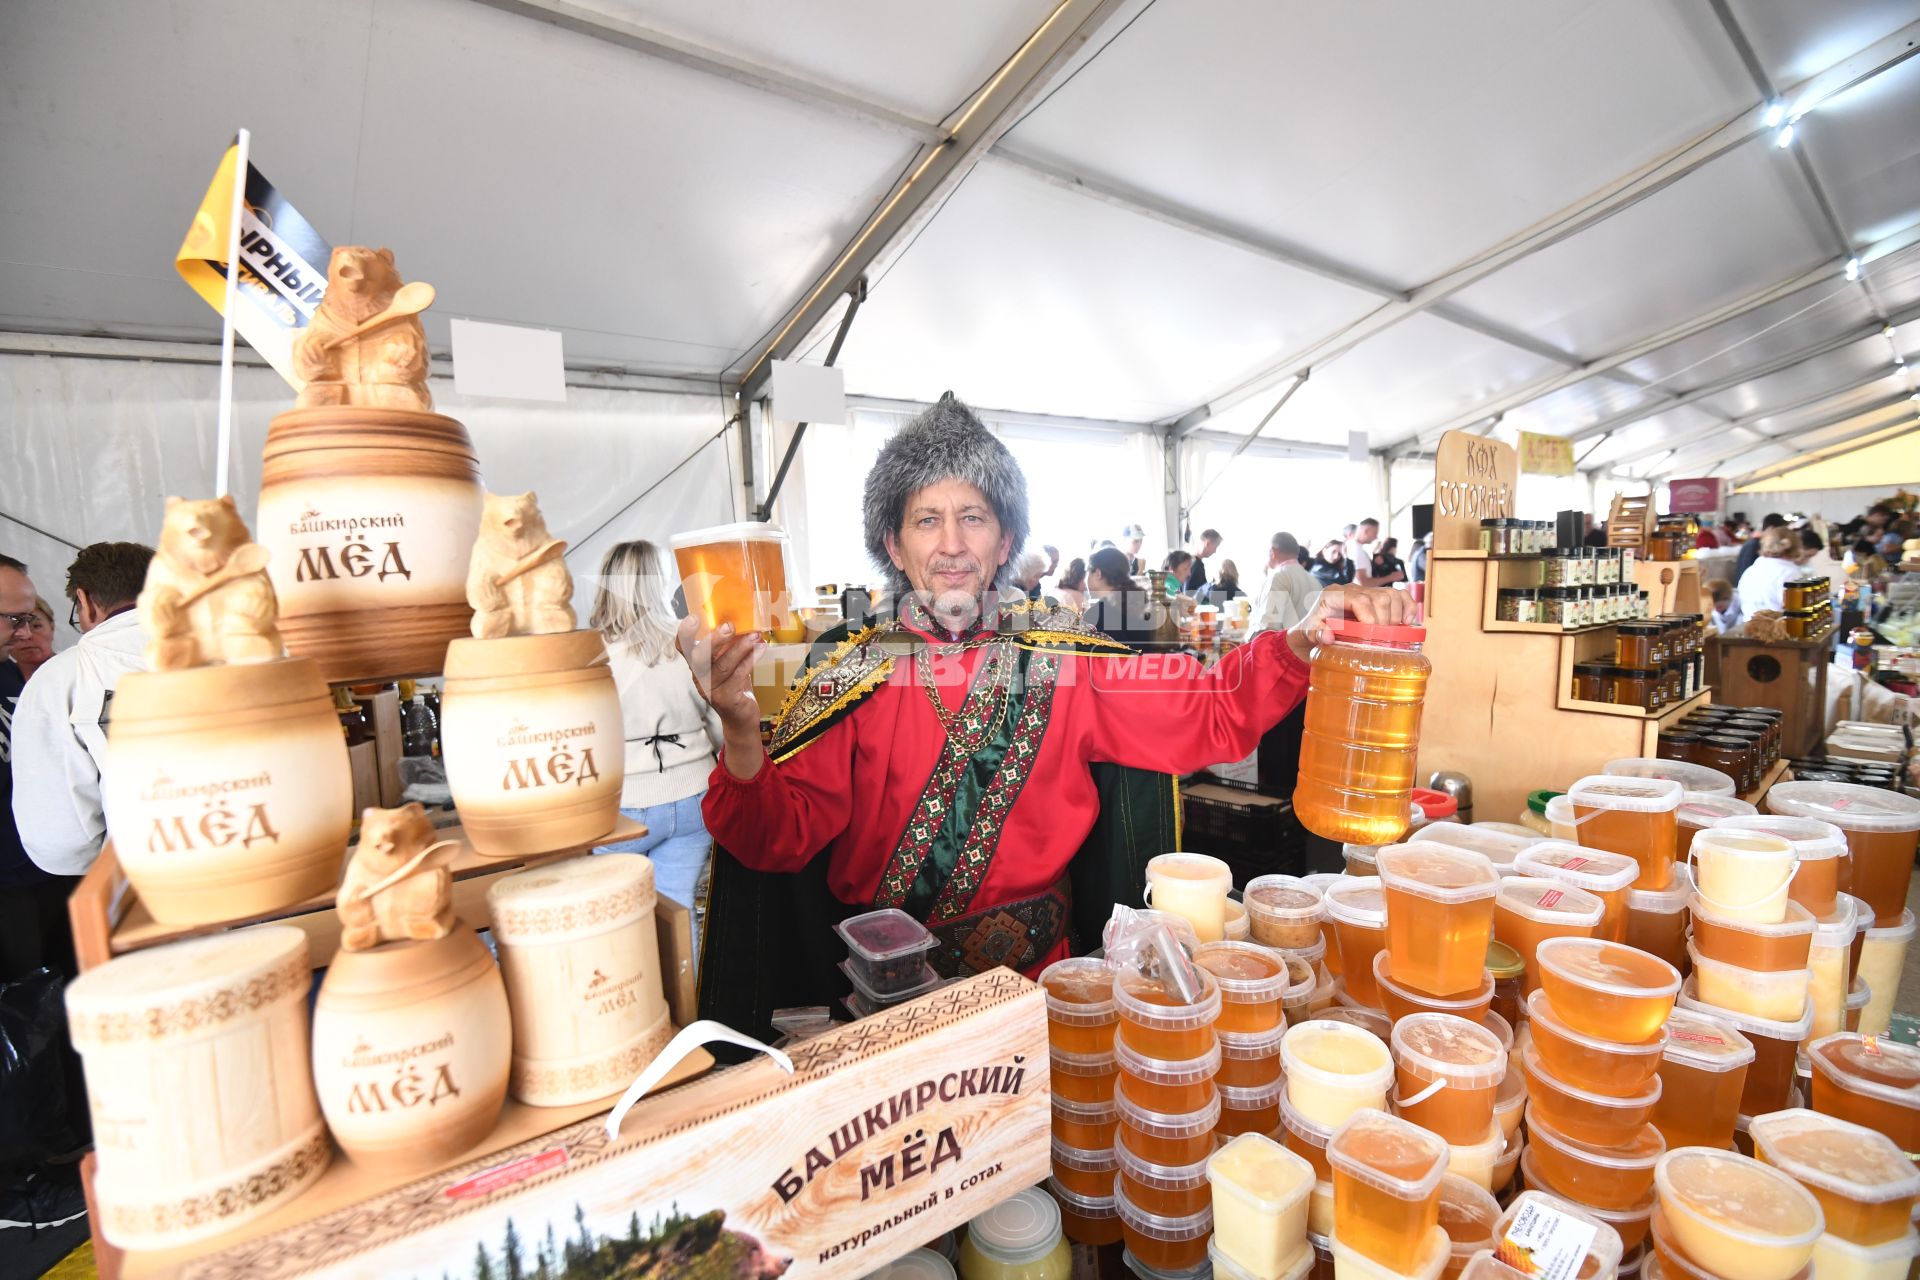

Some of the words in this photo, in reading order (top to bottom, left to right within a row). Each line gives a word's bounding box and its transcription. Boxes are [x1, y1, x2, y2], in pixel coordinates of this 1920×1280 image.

[240, 227, 325, 311] ЫРНЫЙ
[1466, 440, 1498, 480] КФХ
[296, 535, 411, 583] МЁД
[503, 745, 600, 790] МЁД
[771, 1056, 1025, 1205] БАШКИРСКИЙ
[860, 1128, 962, 1202] МЁД
[819, 1193, 939, 1264] натуральный
[945, 1187, 954, 1199] в
[960, 1161, 1003, 1191] сотах
